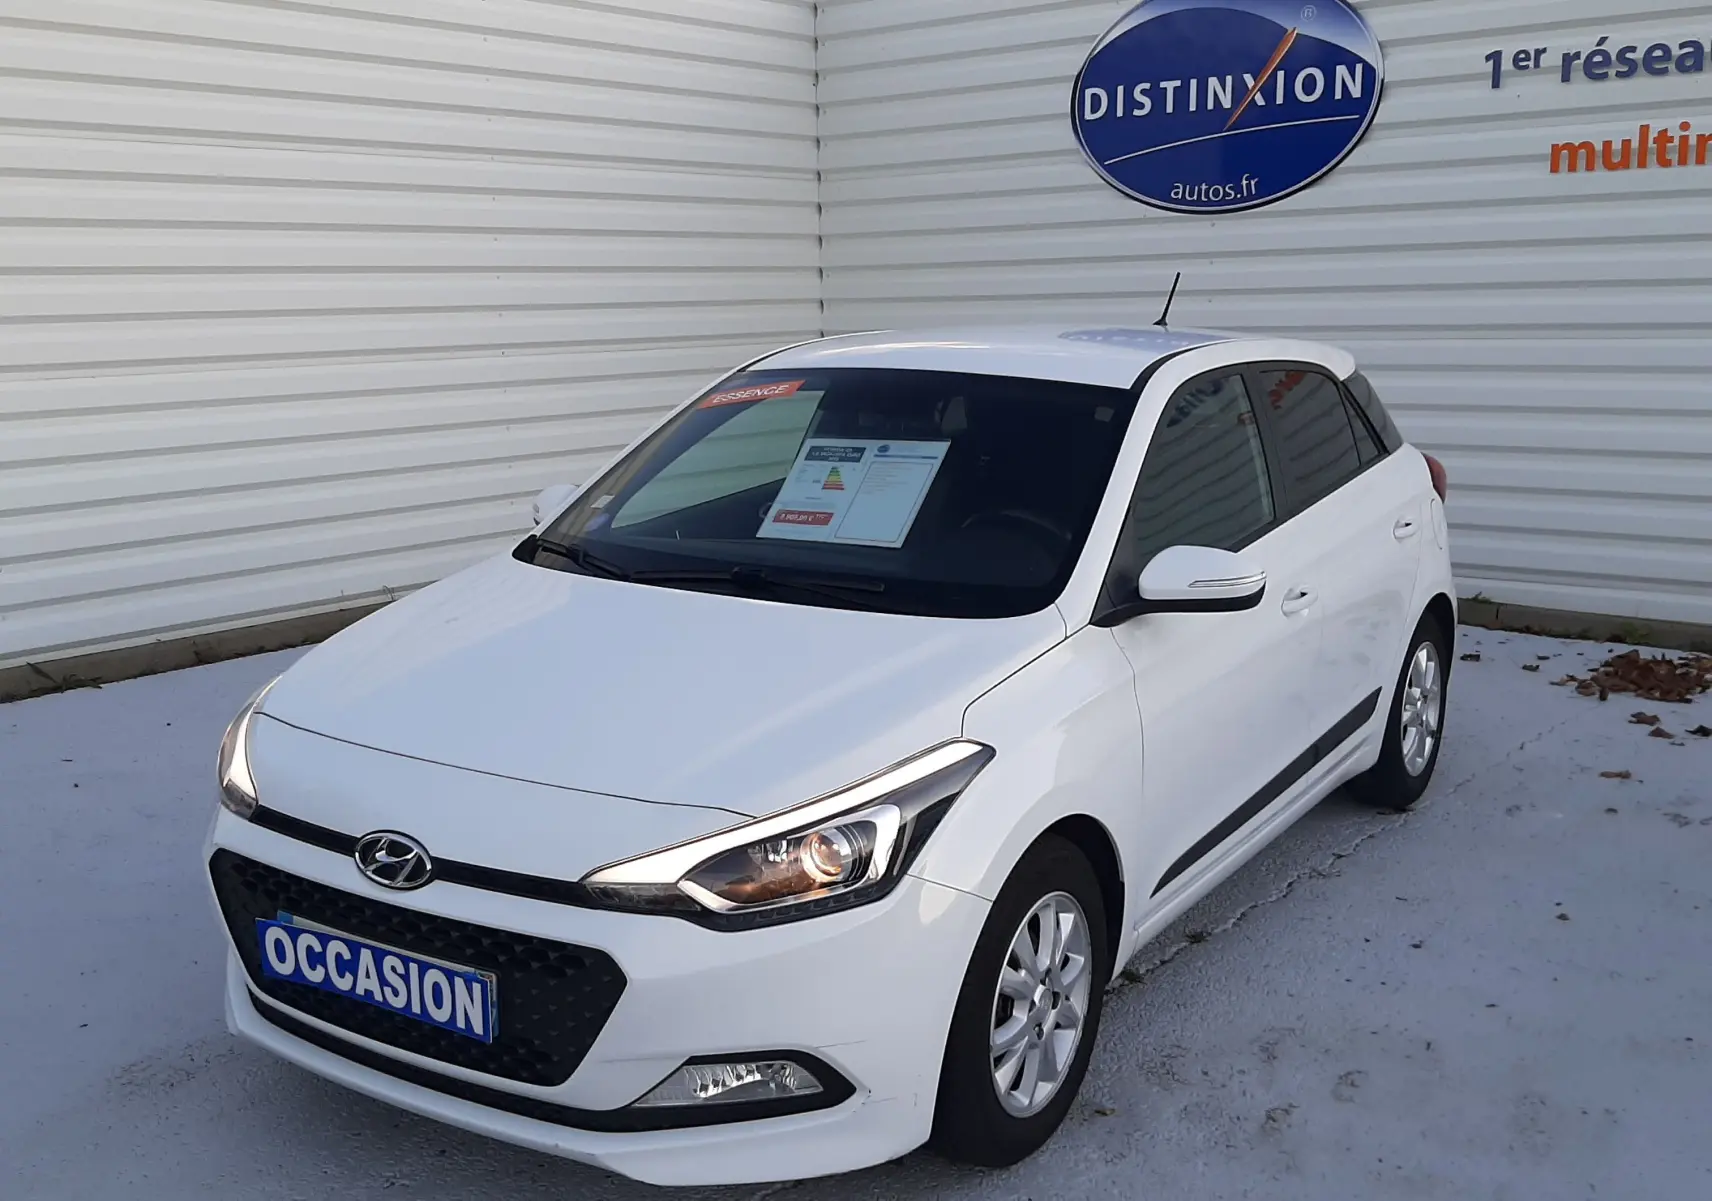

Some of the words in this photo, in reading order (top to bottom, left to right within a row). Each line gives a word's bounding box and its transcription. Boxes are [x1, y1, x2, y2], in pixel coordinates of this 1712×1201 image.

[1484, 46, 1548, 90] 1er
[1560, 35, 1712, 84] résea
[1083, 62, 1364, 122] DISTINXION
[1170, 173, 1260, 201] autos.fr
[712, 384, 790, 404] ESSENCE
[264, 926, 484, 1036] OCCASION
